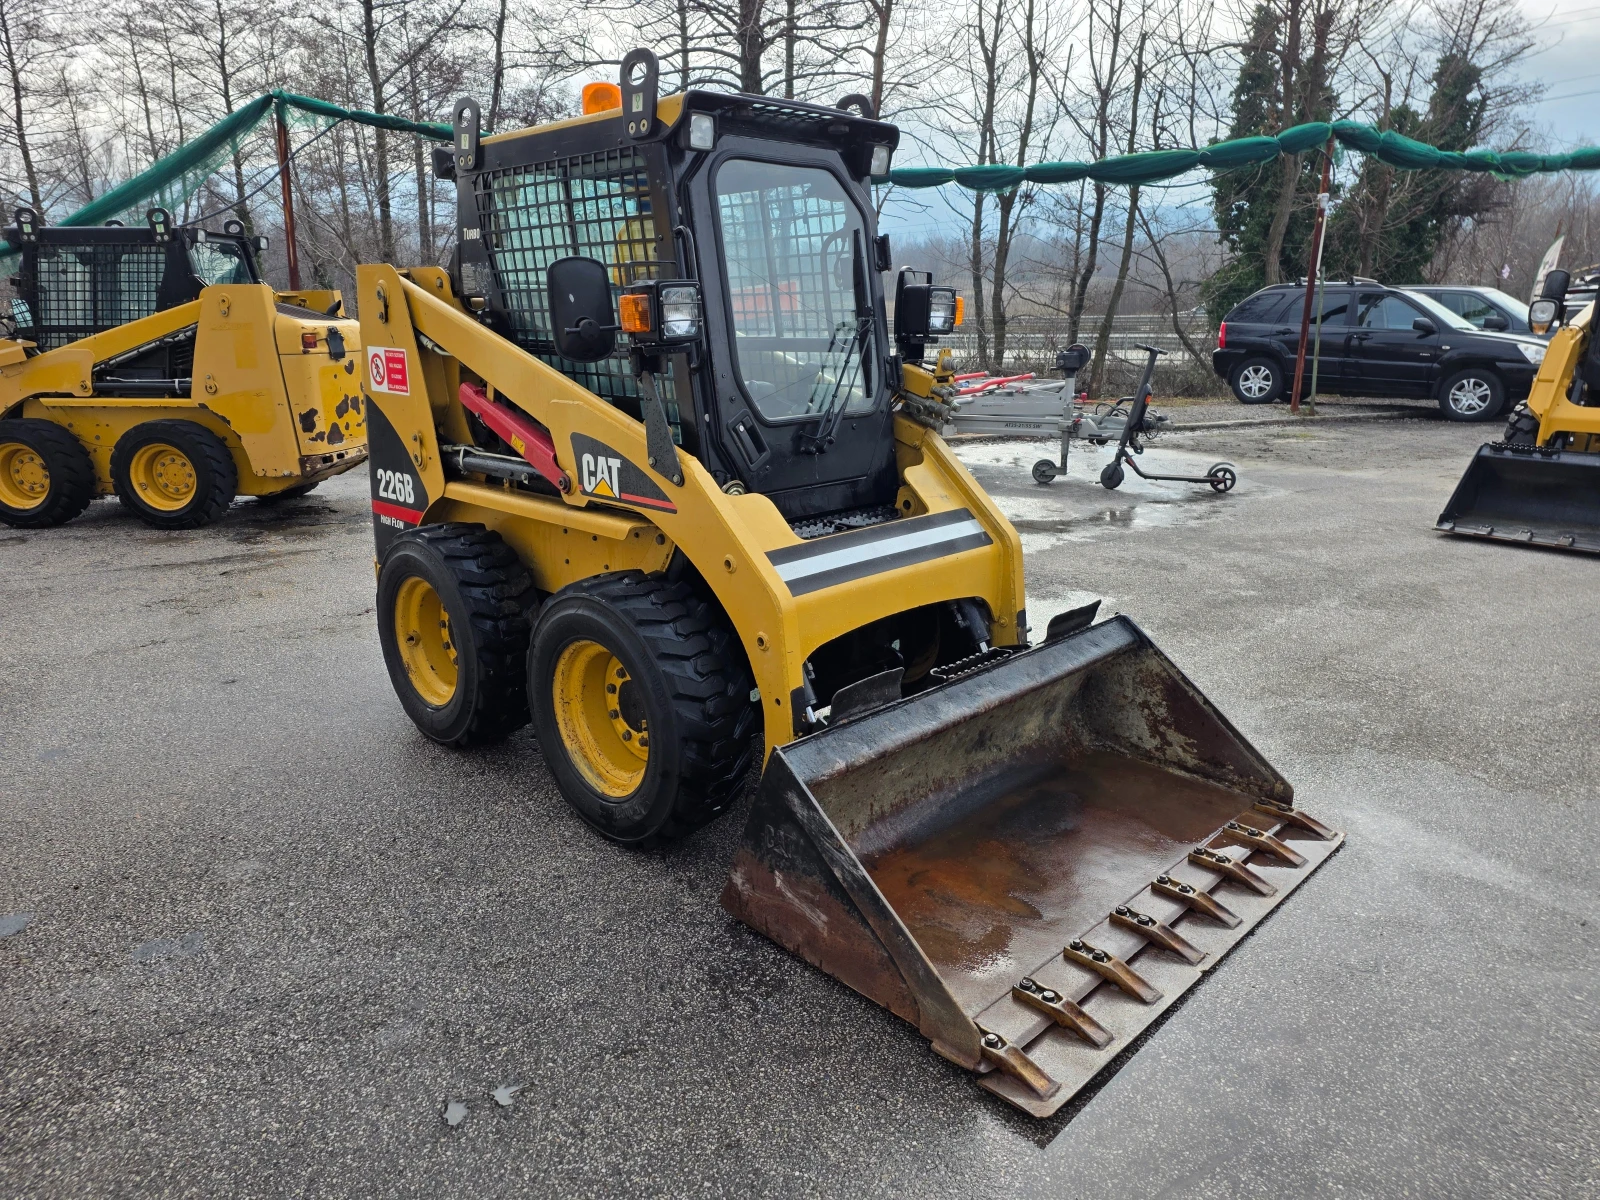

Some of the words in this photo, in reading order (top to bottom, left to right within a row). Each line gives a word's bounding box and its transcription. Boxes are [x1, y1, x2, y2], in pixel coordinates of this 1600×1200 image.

[376, 468, 415, 504] 226B
[581, 453, 621, 499] CAT
[380, 514, 392, 526] HIGH
[391, 517, 405, 530] FLOW
[764, 823, 797, 859] CAT
